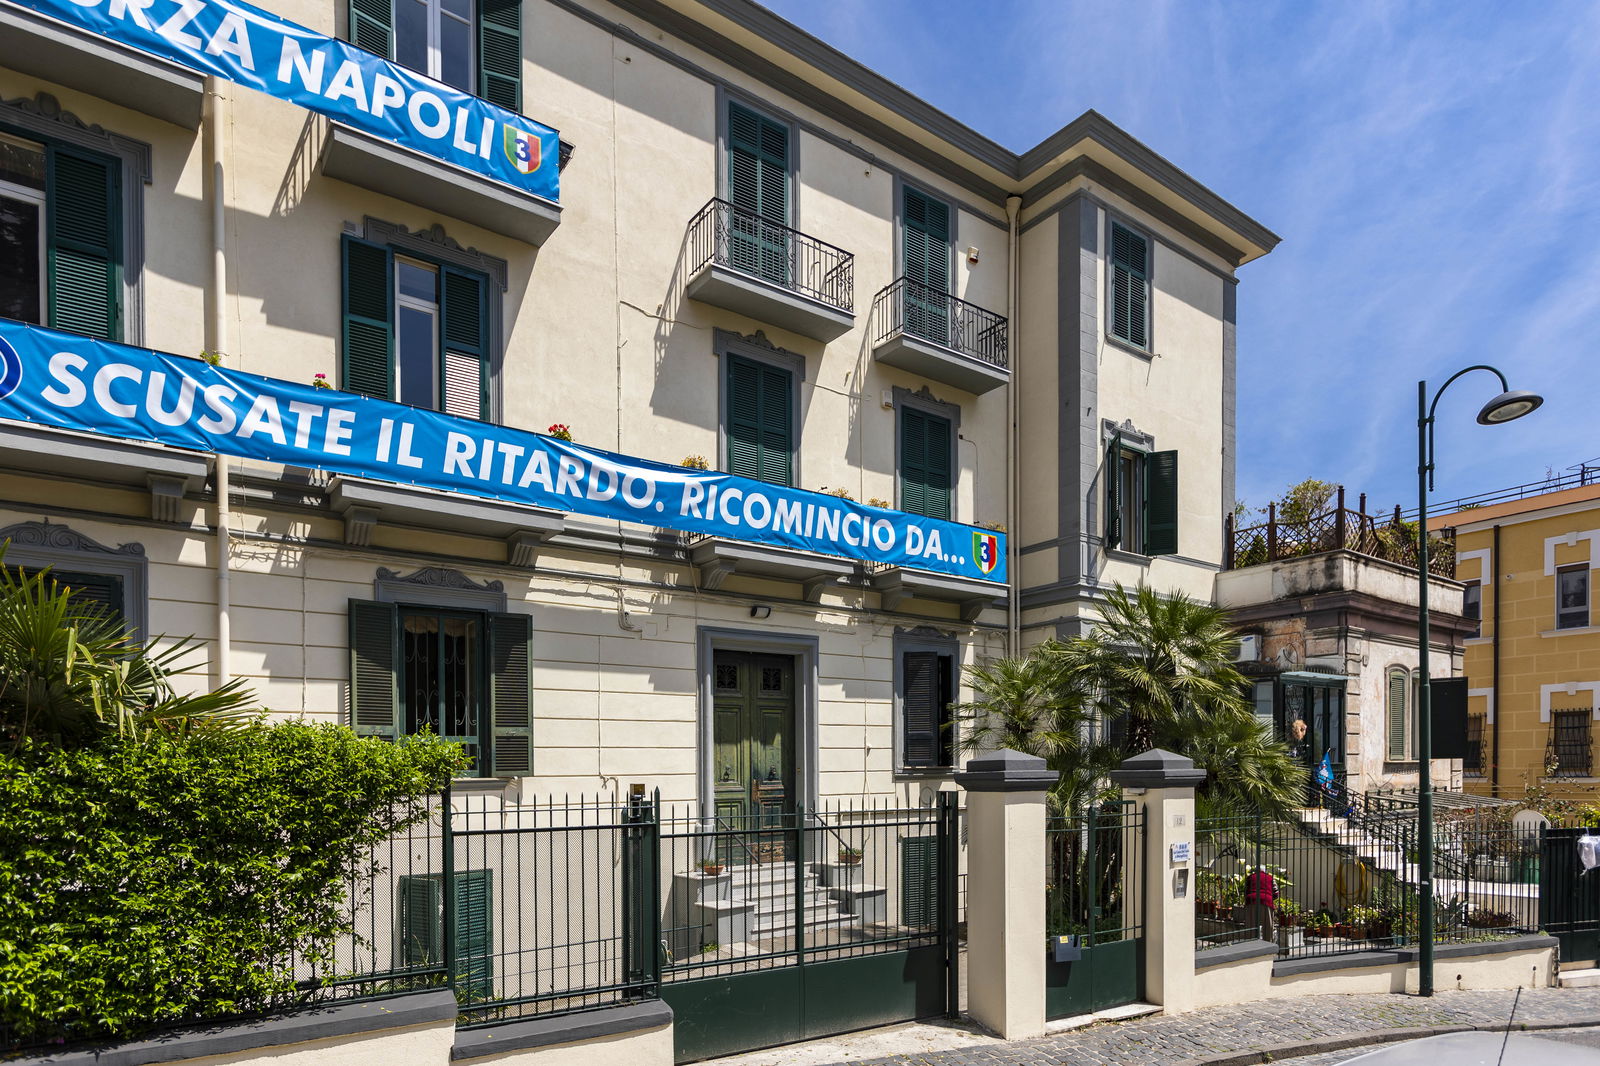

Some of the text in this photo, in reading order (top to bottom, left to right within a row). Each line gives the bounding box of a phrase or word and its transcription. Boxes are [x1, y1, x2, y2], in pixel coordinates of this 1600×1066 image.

[276, 36, 496, 161] NAPOLI
[513, 138, 532, 162] 3
[40, 352, 991, 565] SCUSATE IL RITARDO. RICOMINCIO DA... 3
